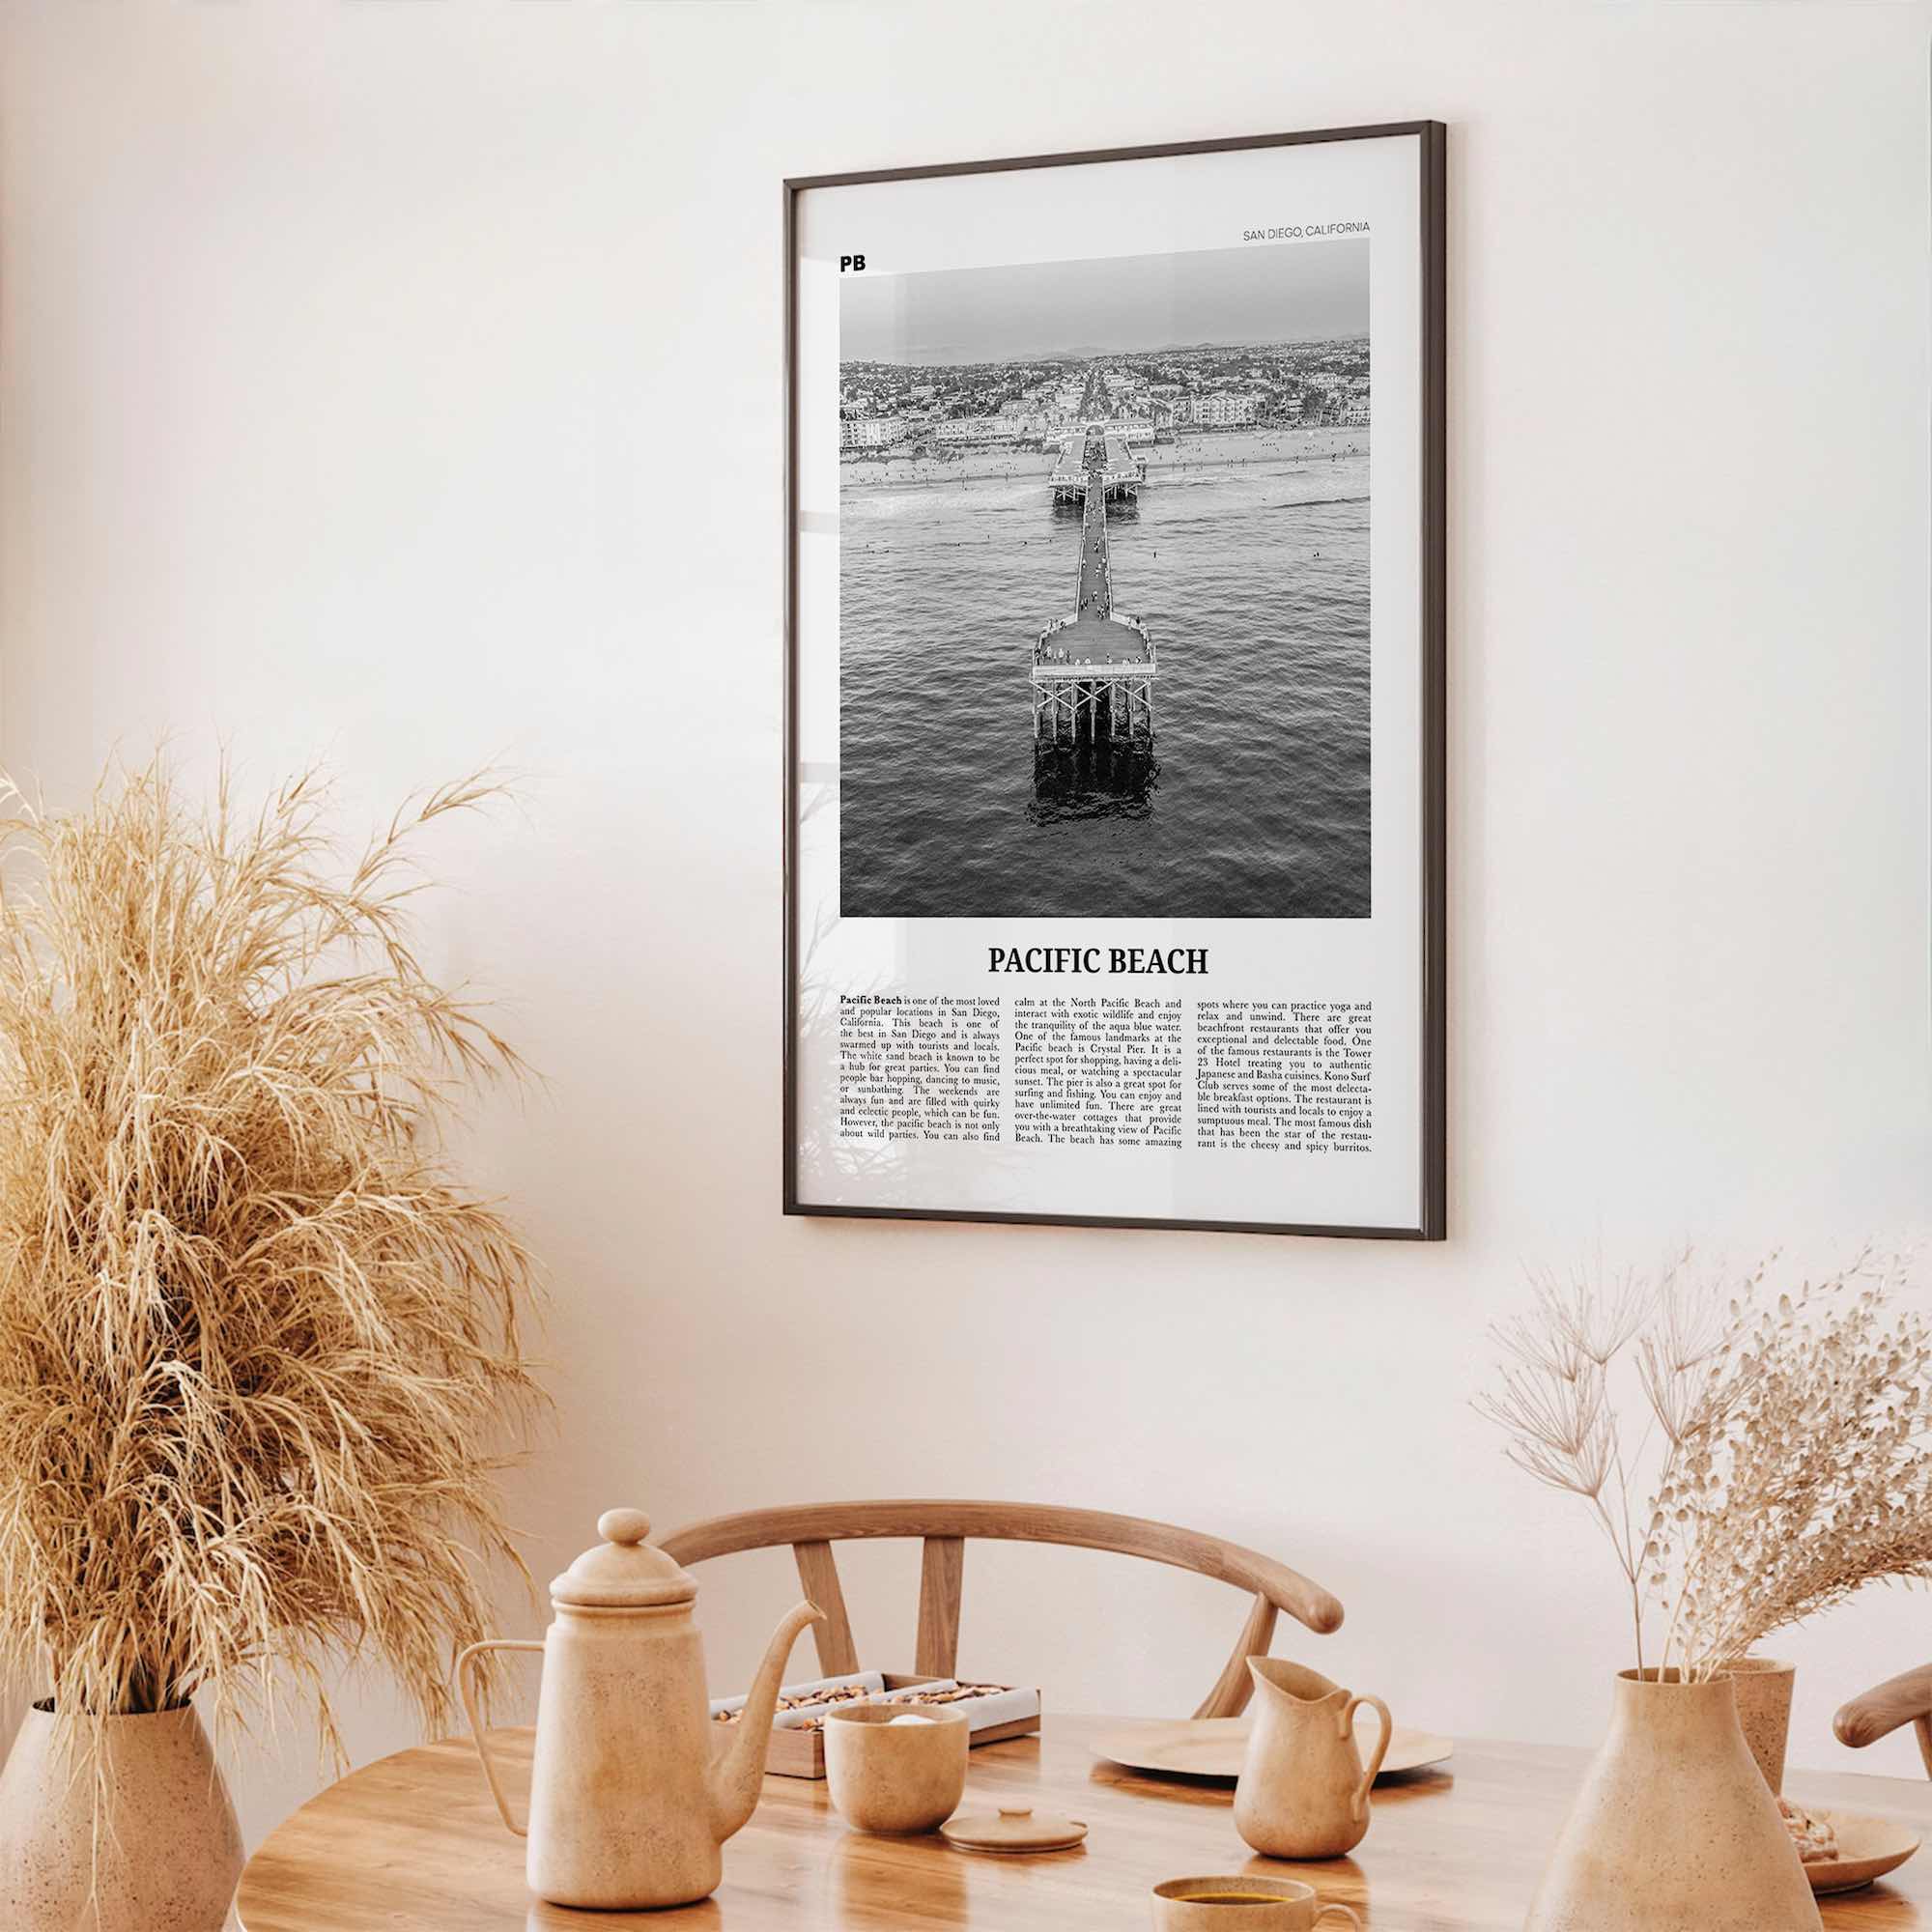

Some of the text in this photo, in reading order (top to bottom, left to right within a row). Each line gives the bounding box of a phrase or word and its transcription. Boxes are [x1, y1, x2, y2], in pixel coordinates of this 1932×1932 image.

[1243, 221, 1371, 242] SAN DIEGO, CALIFORNIA
[840, 254, 867, 272] PB
[988, 948, 1209, 974] PACIFIC BEACH
[839, 995, 872, 1005] Pacific
[873, 996, 902, 1005] Beach
[903, 996, 911, 1005] is
[928, 996, 939, 1005] of
[940, 996, 954, 1005] the
[978, 997, 1000, 1006] loved
[1014, 998, 1036, 1007] calm
[1052, 998, 1065, 1008] the
[1070, 999, 1096, 1008] North
[1101, 999, 1129, 1008] Pacific
[1134, 999, 1160, 1008] Beach
[1165, 999, 1181, 1009] and
[1197, 1001, 1219, 1011] spots
[1222, 1001, 1249, 1009] where
[1252, 1003, 1268, 1012] you
[1291, 1001, 1326, 1012] practice
[1329, 1004, 1351, 1013] yoga
[1354, 1002, 1372, 1010] and
[892, 1018, 911, 1027] This
[919, 1018, 943, 1028] beach
[952, 1019, 958, 1028] is
[989, 1019, 999, 1028] of
[1197, 1011, 1219, 1020] relax
[1226, 1012, 1242, 1021] and
[1293, 1012, 1321, 1022] There
[1348, 1014, 1372, 1025] great
[1014, 1020, 1028, 1030] the
[1031, 1021, 1076, 1033] tranquility
[1078, 1021, 1089, 1030] of
[1092, 1021, 1106, 1031] the
[1109, 1024, 1130, 1034] aqua
[1133, 1022, 1152, 1031] blue
[1014, 1032, 1034, 1040] One
[1037, 1032, 1047, 1041] of
[1052, 1033, 1065, 1041] the
[1070, 1033, 1101, 1041] famous
[1105, 1034, 1151, 1042] landmarks
[1167, 1034, 1181, 1043] the
[839, 1039, 876, 1049] swarmed
[880, 1042, 892, 1052] up
[895, 1040, 914, 1049] with
[919, 1041, 949, 1050] tourists
[952, 1041, 969, 1050] and
[1015, 1043, 1042, 1052] Pacific
[1047, 1043, 1073, 1053] beach
[1078, 1044, 1085, 1053] is
[1090, 1044, 1122, 1056] Crystal
[1151, 1045, 1158, 1054] It
[1164, 1045, 1171, 1054] is
[1197, 1046, 1207, 1055] of
[1210, 1046, 1225, 1056] the
[1228, 1047, 1260, 1056] famous
[1315, 1048, 1322, 1057] is
[1325, 1048, 1340, 1057] the
[1343, 1049, 1372, 1058] Tower
[848, 1062, 866, 1071] hub
[868, 1063, 881, 1071] for
[884, 1064, 906, 1074] great
[945, 1064, 960, 1072] You
[981, 1065, 1000, 1073] find
[1197, 1058, 1208, 1066] 23
[1215, 1059, 1240, 1067] Hotel
[1247, 1059, 1282, 1070] treating
[1289, 1062, 1305, 1071] you
[1329, 1061, 1372, 1069] authentic
[1014, 1065, 1037, 1074] cious
[1081, 1067, 1120, 1079] watching
[1132, 1068, 1182, 1080] spectacular
[1195, 1069, 1236, 1082] Japanese
[1236, 1070, 1254, 1079] and
[1256, 1070, 1283, 1080] Basha
[1324, 1072, 1350, 1081] Kono
[1350, 1072, 1371, 1081] Surf
[839, 1095, 867, 1107] always
[870, 1095, 884, 1105] fun
[888, 1096, 904, 1105] and
[925, 1097, 947, 1106] filled
[951, 1097, 969, 1106] with
[973, 1098, 1001, 1110] quirky
[1014, 1089, 1044, 1100] surfing
[1046, 1089, 1063, 1098] and
[1101, 1091, 1117, 1099] You
[1138, 1092, 1162, 1103] enjoy
[1165, 1092, 1182, 1100] and
[839, 1106, 855, 1115] and
[858, 1107, 889, 1116] eclectic
[923, 1108, 949, 1117] which
[970, 1109, 980, 1118] be
[1014, 1099, 1035, 1109] have
[1039, 1100, 1080, 1109] unlimited
[1108, 1102, 1135, 1111] There
[1159, 1104, 1181, 1115] great
[1197, 1104, 1219, 1113] lined
[1222, 1105, 1241, 1114] with
[1244, 1105, 1277, 1115] tourists
[1279, 1106, 1296, 1115] and
[1298, 1107, 1324, 1116] locals
[1339, 1107, 1364, 1119] enjoy
[839, 1128, 863, 1137] about
[867, 1129, 885, 1138] wild
[923, 1130, 939, 1139] You
[960, 1131, 980, 1140] also
[983, 1132, 1000, 1141] find
[1220, 1140, 1228, 1149] is
[1232, 1140, 1246, 1149] the
[1250, 1141, 1280, 1152] cheesy
[1284, 1142, 1301, 1151] and
[1305, 1142, 1329, 1153] spicy
